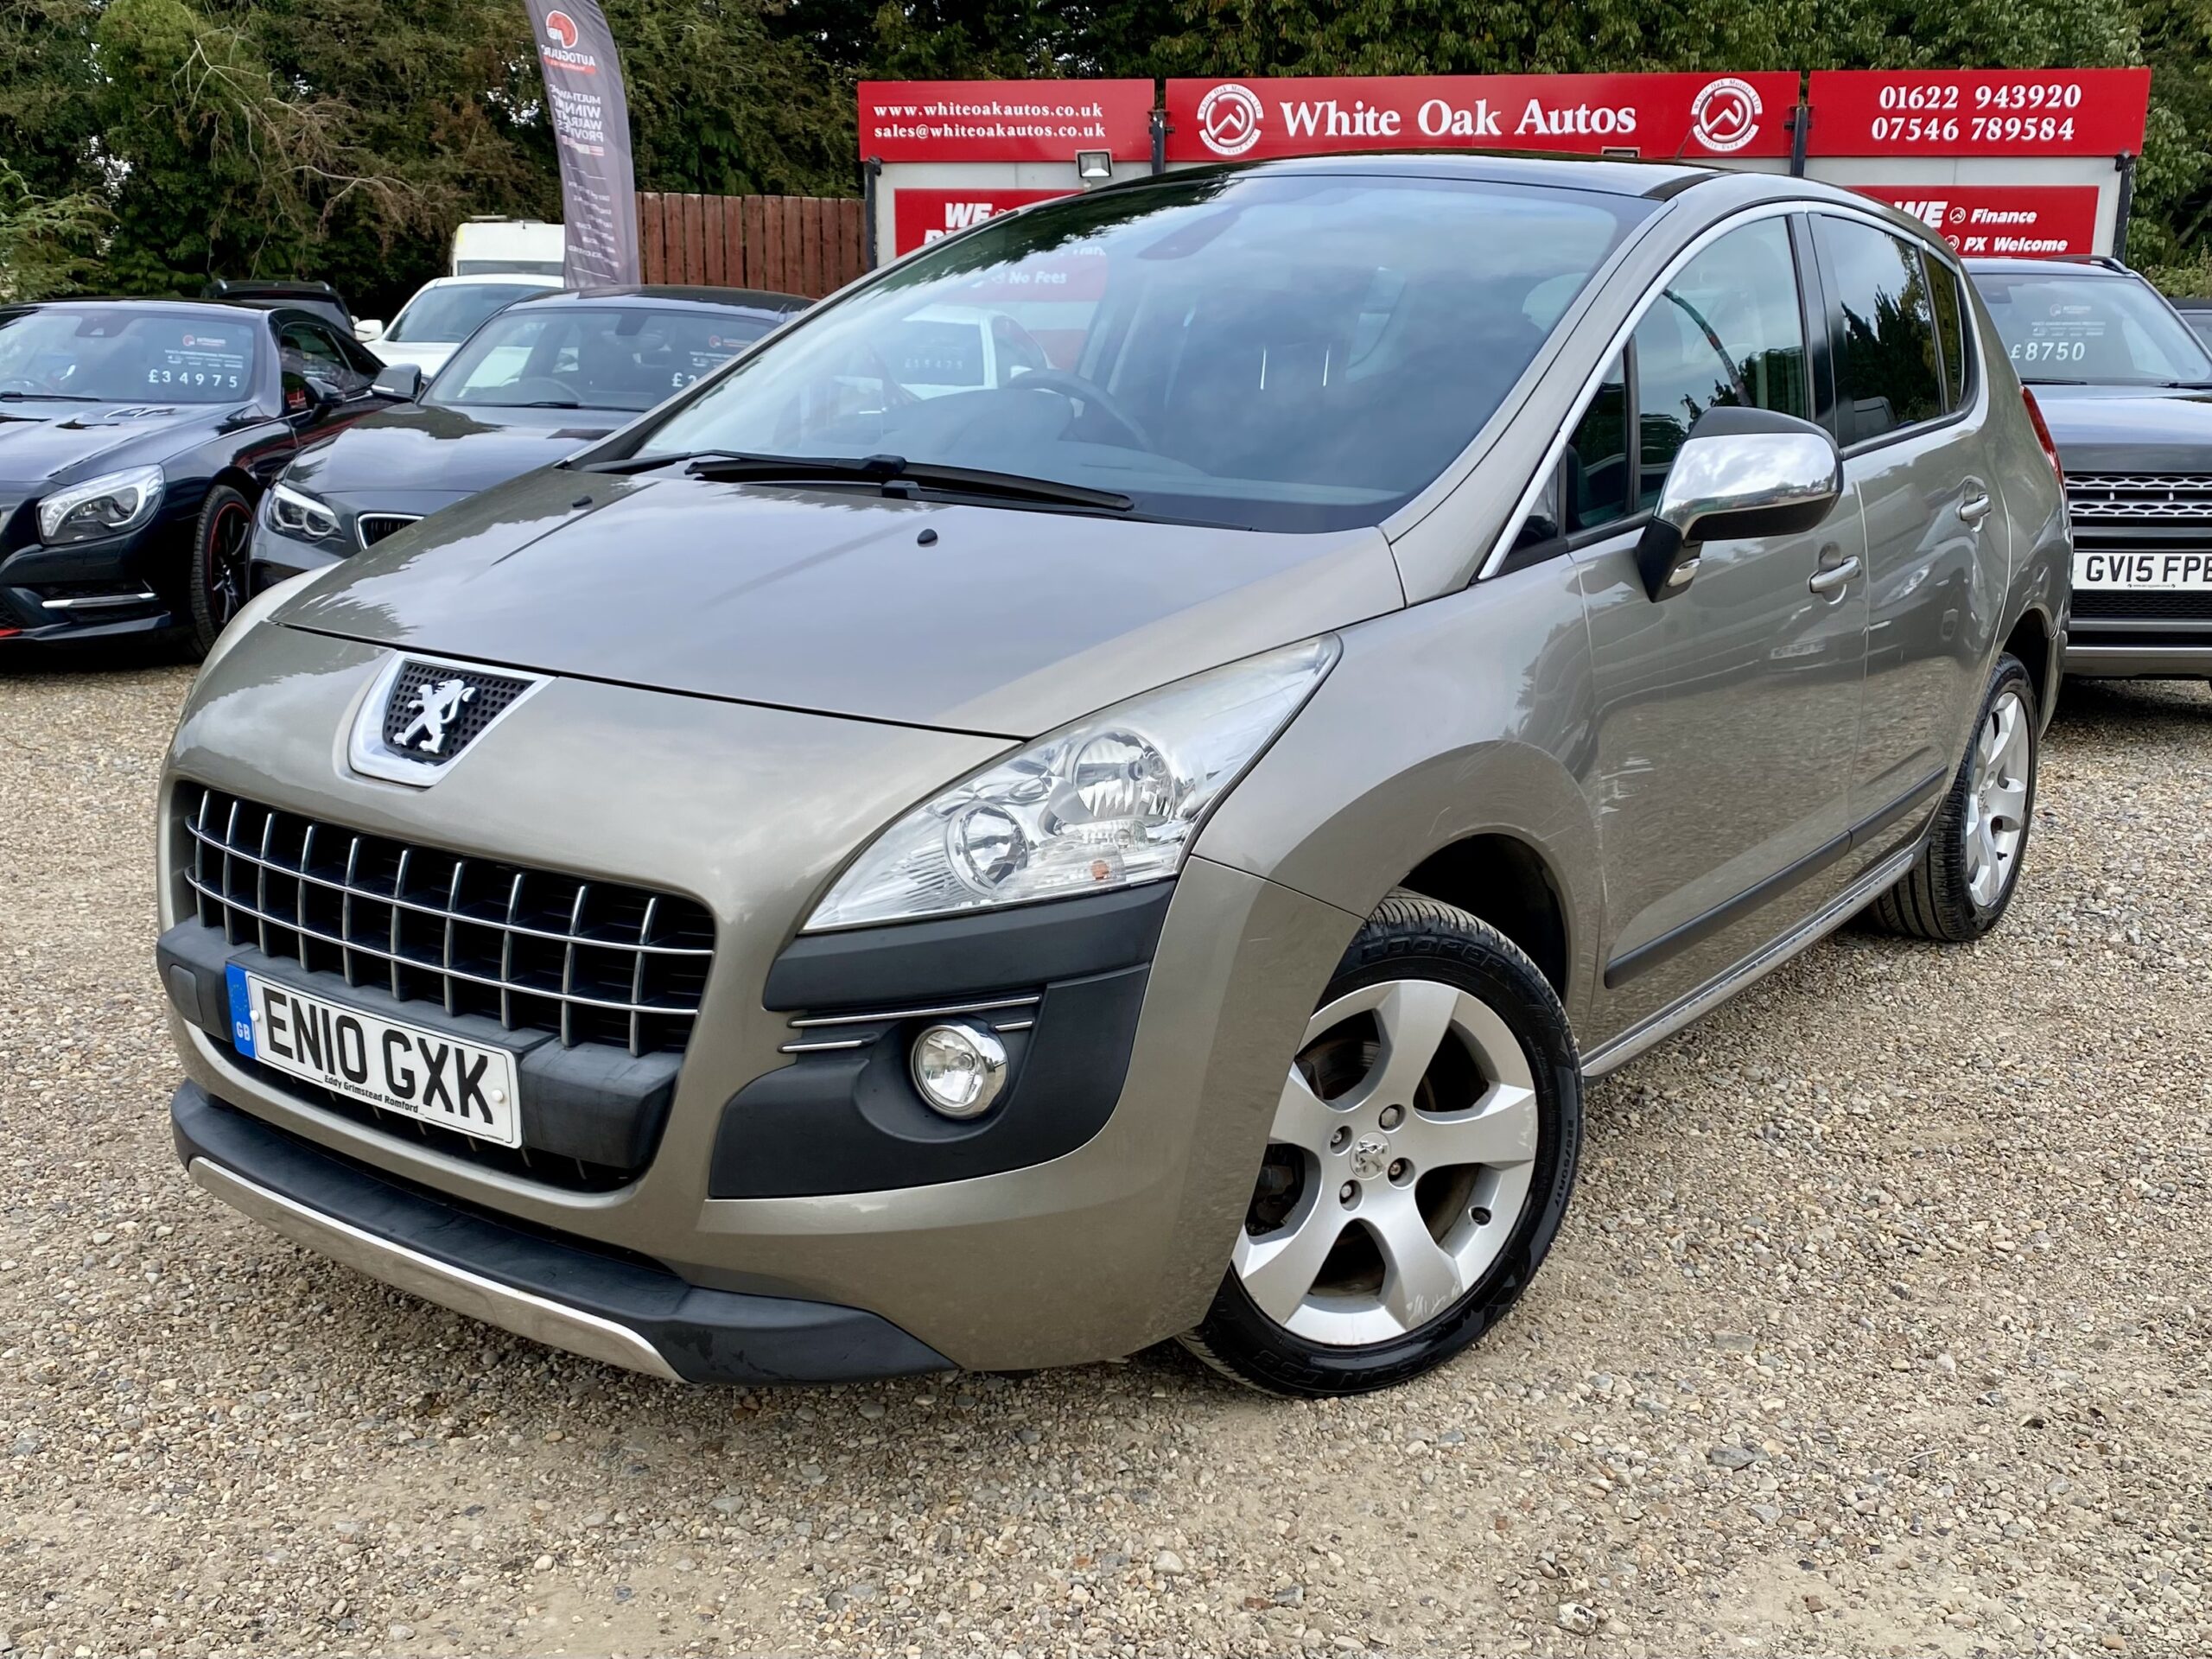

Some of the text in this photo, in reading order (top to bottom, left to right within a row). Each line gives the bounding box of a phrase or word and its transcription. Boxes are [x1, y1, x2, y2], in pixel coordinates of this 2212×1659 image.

[1878, 84, 2082, 110] 01622 943920
[874, 102, 1103, 117] www.whiteoakautos.co.uk
[1280, 99, 1637, 137] White Oak Autos
[874, 123, 1106, 139] sales@whiteoakautos.co.uk
[1872, 117, 2075, 141] 07546 789584
[945, 202, 993, 227] WE
[1893, 200, 1948, 228] WE
[1970, 208, 2037, 224] Finance
[1963, 237, 2068, 251] PX Welcome
[1008, 271, 1067, 284] No Fees
[2010, 341, 2085, 361] £8750
[149, 369, 238, 388] £34975
[2086, 556, 2154, 582] GV15
[236, 1021, 251, 1041] GB
[262, 987, 493, 1125] EN10 GXK
[325, 1075, 419, 1113] Eddy Grimstead Romford
